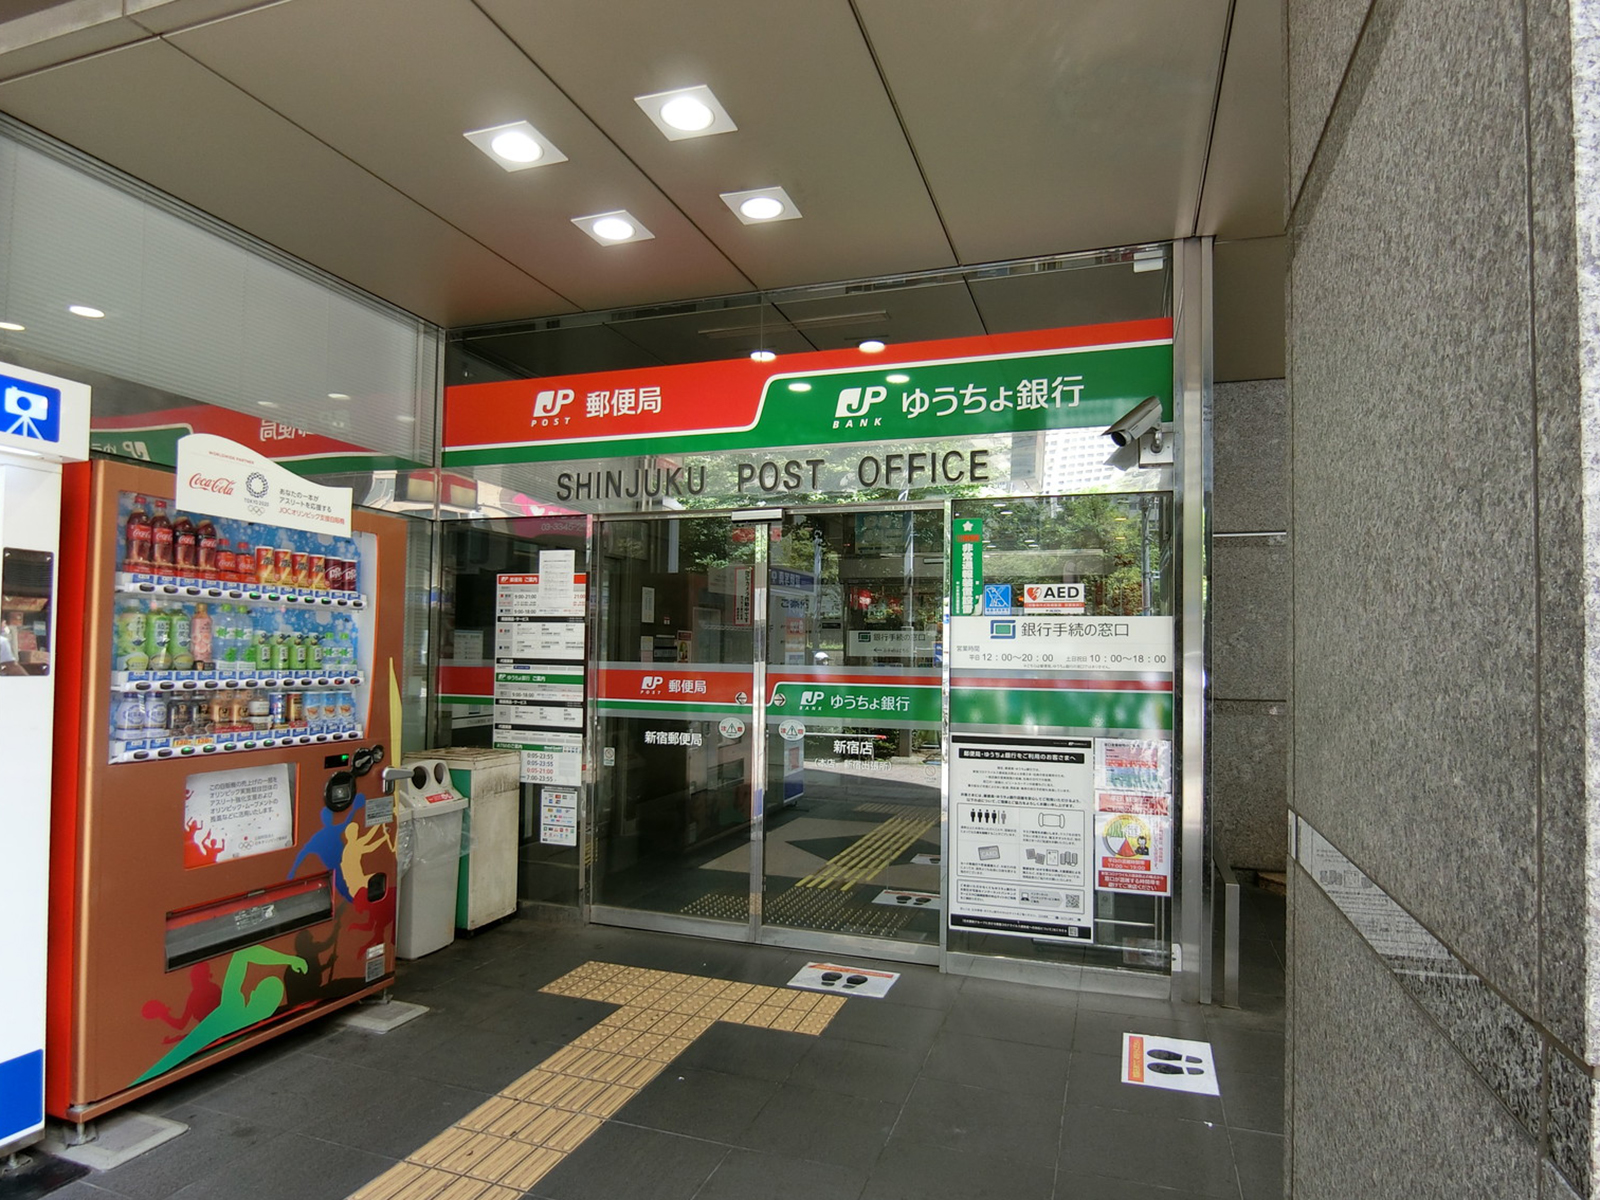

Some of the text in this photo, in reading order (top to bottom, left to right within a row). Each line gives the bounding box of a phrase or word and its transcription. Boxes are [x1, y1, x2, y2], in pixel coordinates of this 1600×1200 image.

[533, 386, 662, 419] JP 郵便局
[834, 375, 1085, 419] JP ゆうちょ銀行
[531, 417, 571, 427] POST
[832, 417, 883, 429] BANK
[556, 449, 989, 502] SHINJUKU POST OFFICE
[189, 473, 237, 496] Coca-Cola
[279, 488, 319, 502] あなたの一本が
[279, 496, 332, 513] アスリートを応援する
[1044, 586, 1080, 598] AED
[1021, 622, 1129, 637] 銀行手続の窓口
[641, 676, 707, 694] JP 郵便局
[800, 691, 910, 712] JP ゆうちょ銀行
[644, 730, 703, 747] 新宿郵便局
[833, 739, 873, 756] 新宿店
